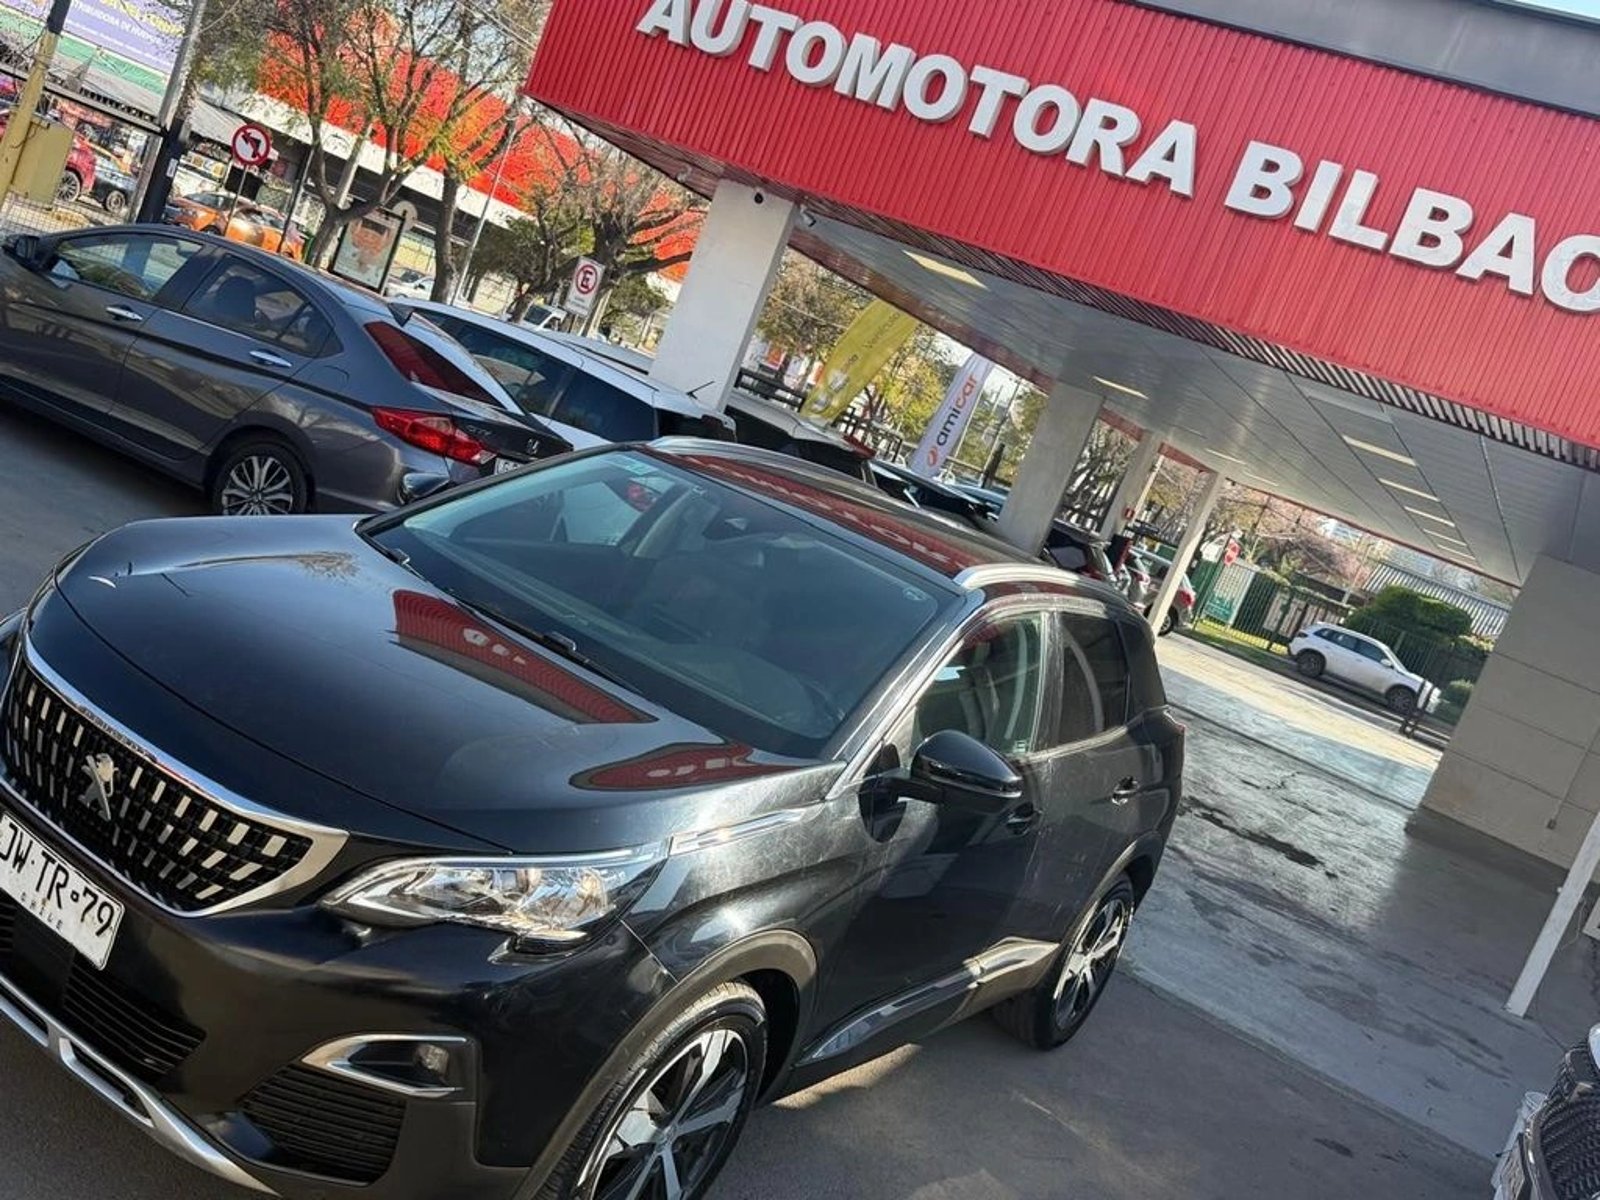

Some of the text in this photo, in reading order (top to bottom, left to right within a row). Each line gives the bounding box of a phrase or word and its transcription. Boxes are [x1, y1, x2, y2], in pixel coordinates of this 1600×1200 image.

[636, 0, 1600, 313] AUTOMOTORA BILBAO
[936, 373, 977, 446] amicar
